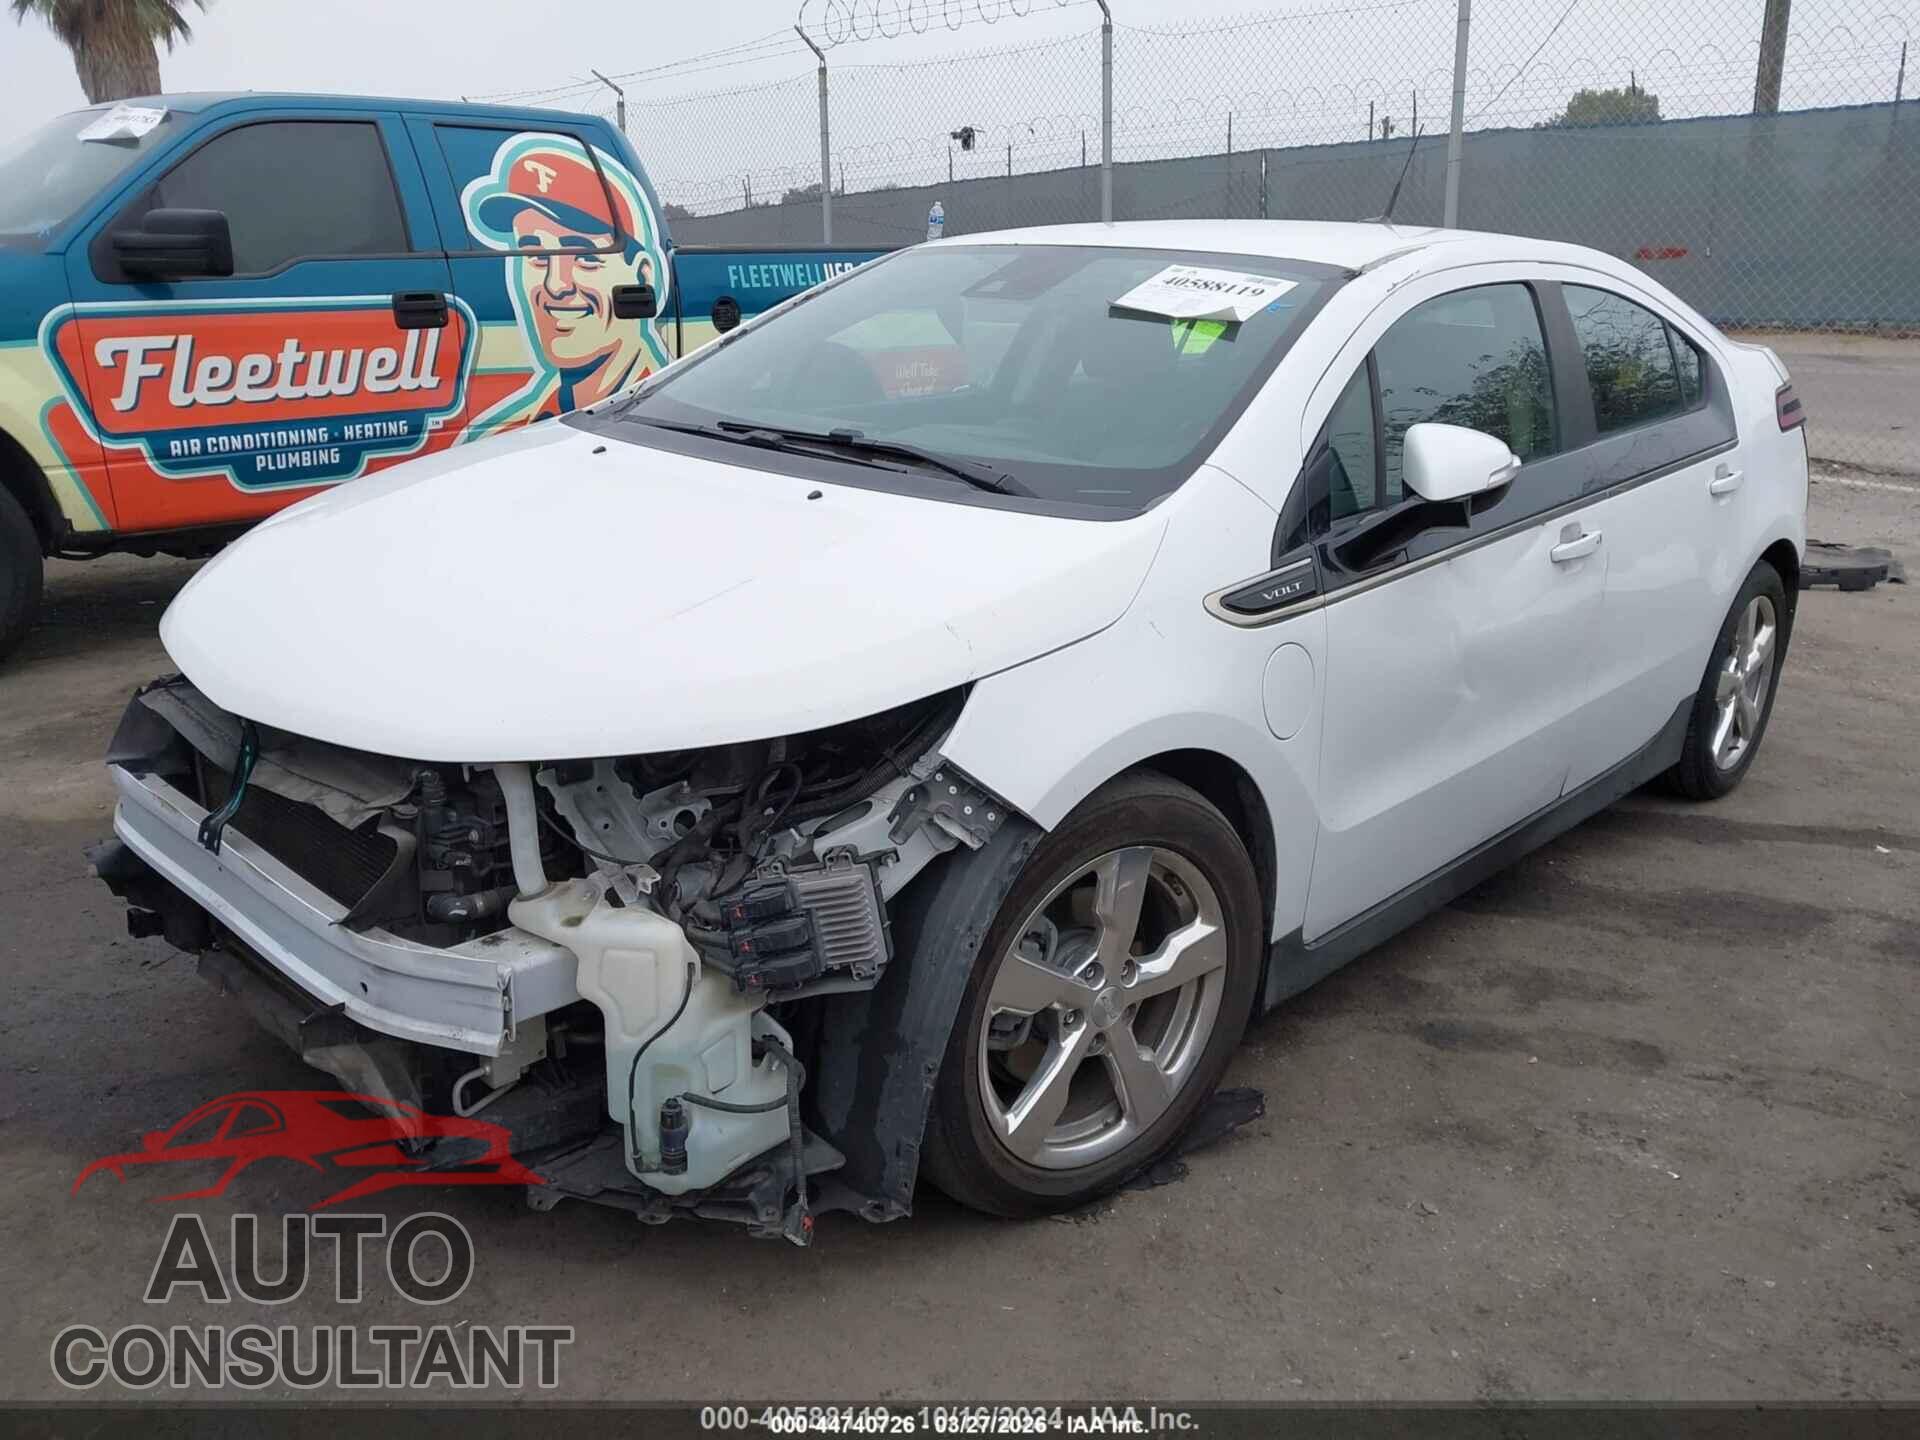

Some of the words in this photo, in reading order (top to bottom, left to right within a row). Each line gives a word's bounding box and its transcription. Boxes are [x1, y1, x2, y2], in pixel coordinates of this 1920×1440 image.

[524, 160, 557, 192] F
[1163, 276, 1266, 297] 40588119
[94, 328, 441, 412] Fleetwell
[169, 438, 203, 458] AIR
[207, 427, 329, 454] CONDITIONING
[343, 420, 409, 441] HEATING
[255, 448, 341, 472] PLUMBING
[1262, 581, 1303, 600] VOLT
